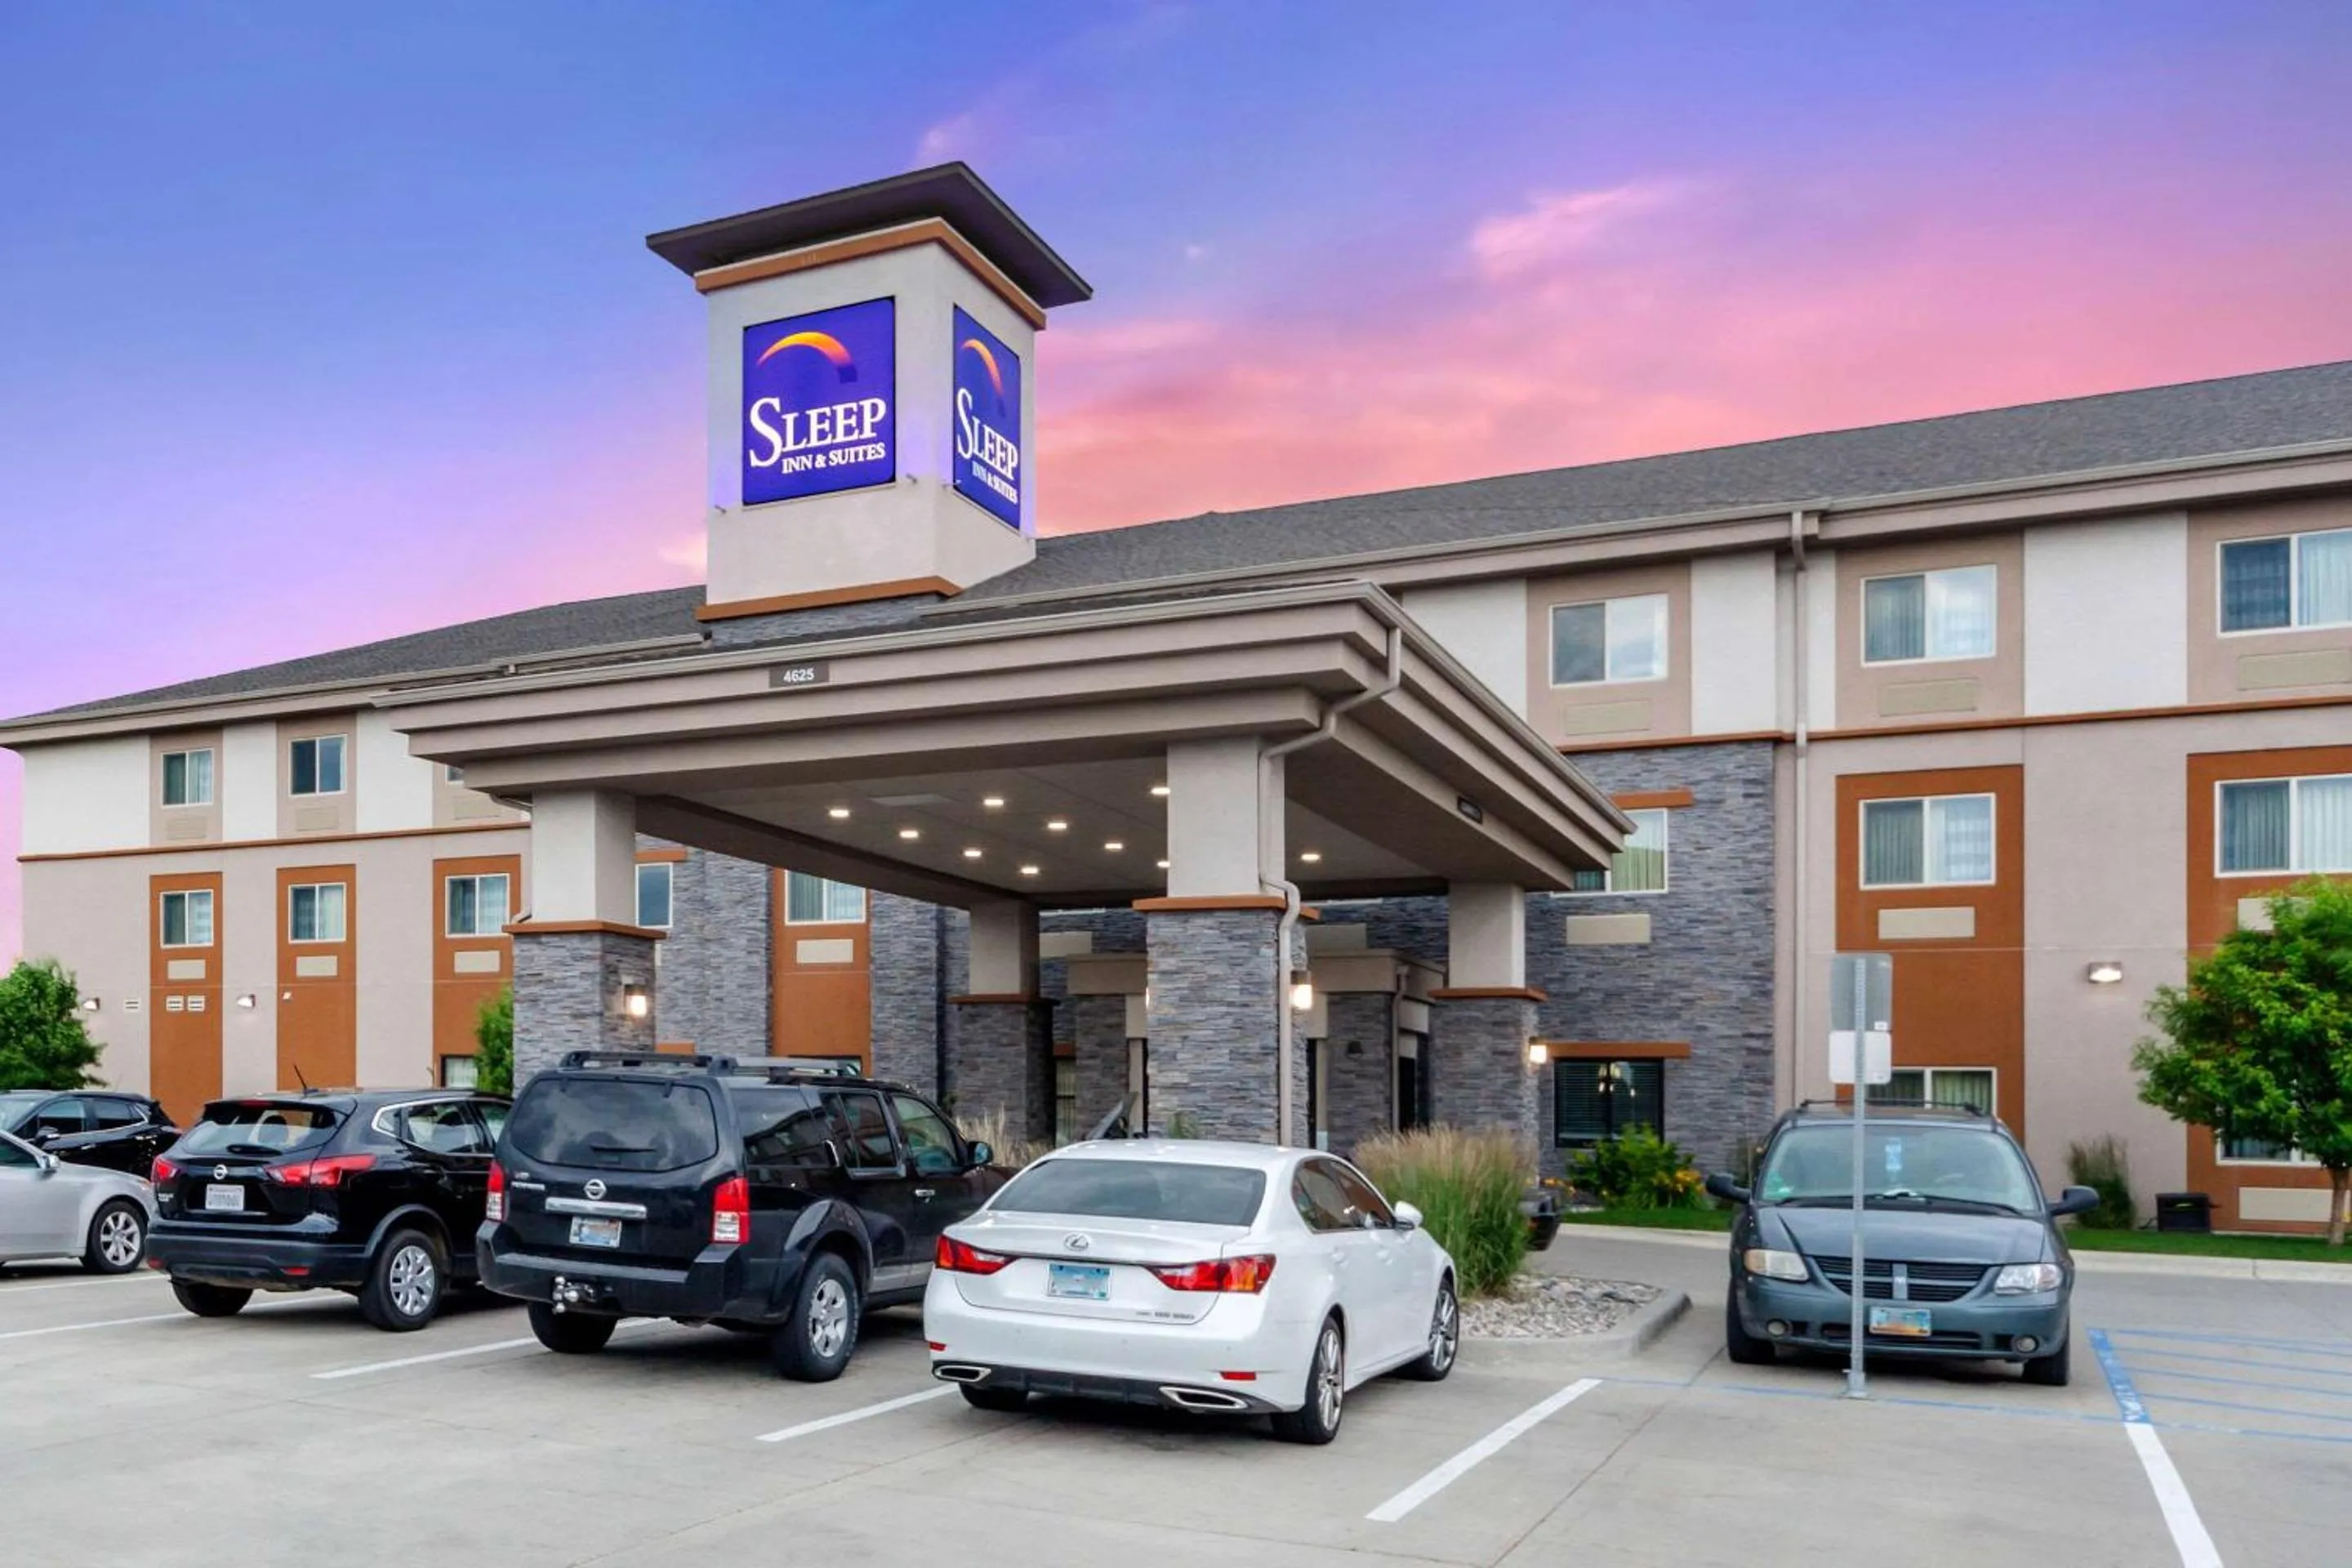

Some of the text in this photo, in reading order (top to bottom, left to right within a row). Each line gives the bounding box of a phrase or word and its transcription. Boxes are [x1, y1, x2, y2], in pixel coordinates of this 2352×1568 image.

[749, 397, 886, 468] SLEEP
[782, 442, 886, 474] INN & SUITES
[957, 388, 1018, 480] SLEEP
[783, 668, 815, 683] 4625
